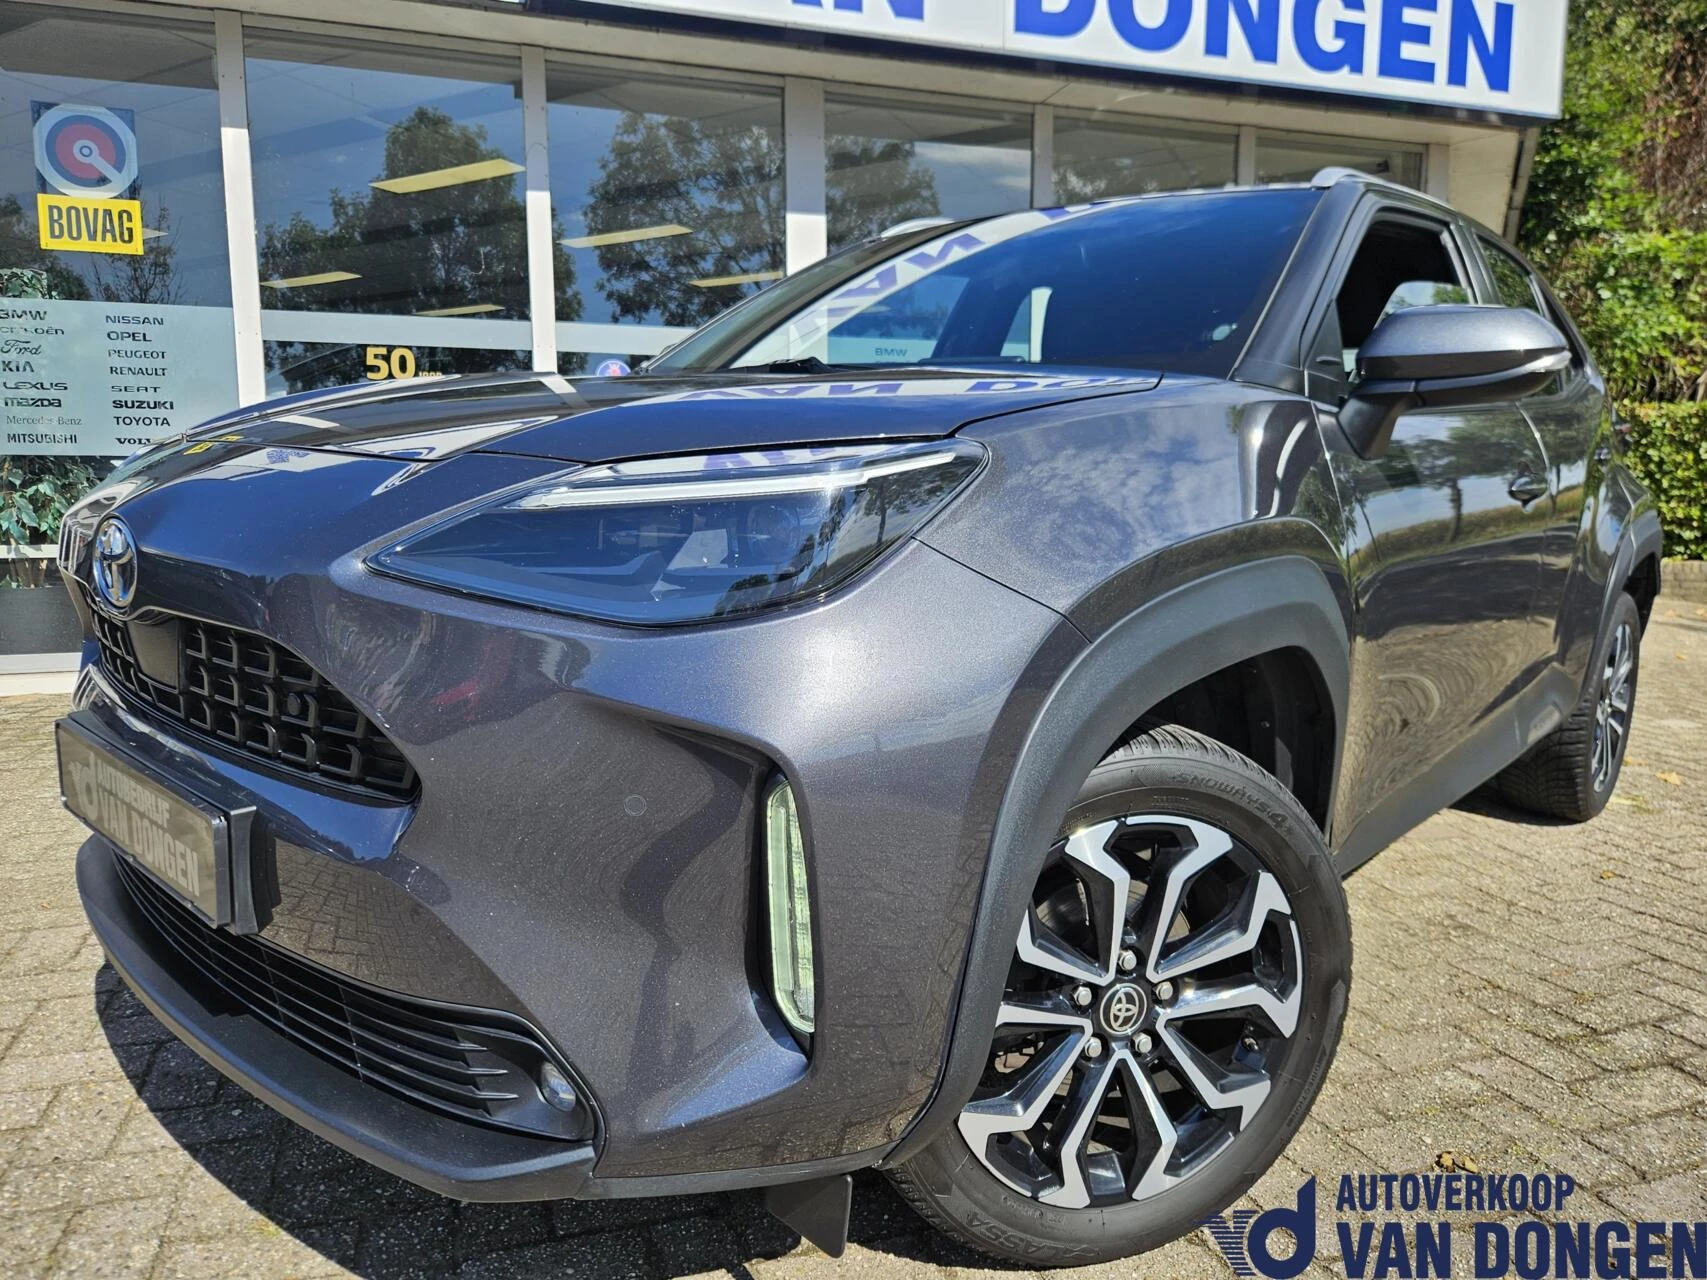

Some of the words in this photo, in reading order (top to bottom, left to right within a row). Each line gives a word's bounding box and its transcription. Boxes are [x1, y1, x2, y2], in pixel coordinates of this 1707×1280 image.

[47, 204, 134, 244] BOVAG
[0, 309, 47, 320] BMW
[105, 315, 164, 325] NISSAN
[106, 331, 152, 342] OPEL
[107, 349, 167, 359] PEUGEOT
[1, 360, 35, 372] KIA
[366, 346, 416, 381] 50
[109, 366, 168, 376] RENAULT
[3, 381, 68, 391] LEXUS
[111, 385, 161, 393] SEAT
[112, 400, 174, 410] SUZUKI
[113, 416, 171, 427] TOYOTA
[7, 433, 78, 444] MITSUBISHI
[114, 437, 152, 445] VOL
[100, 787, 130, 845] VAN
[130, 810, 200, 897] DONGEN
